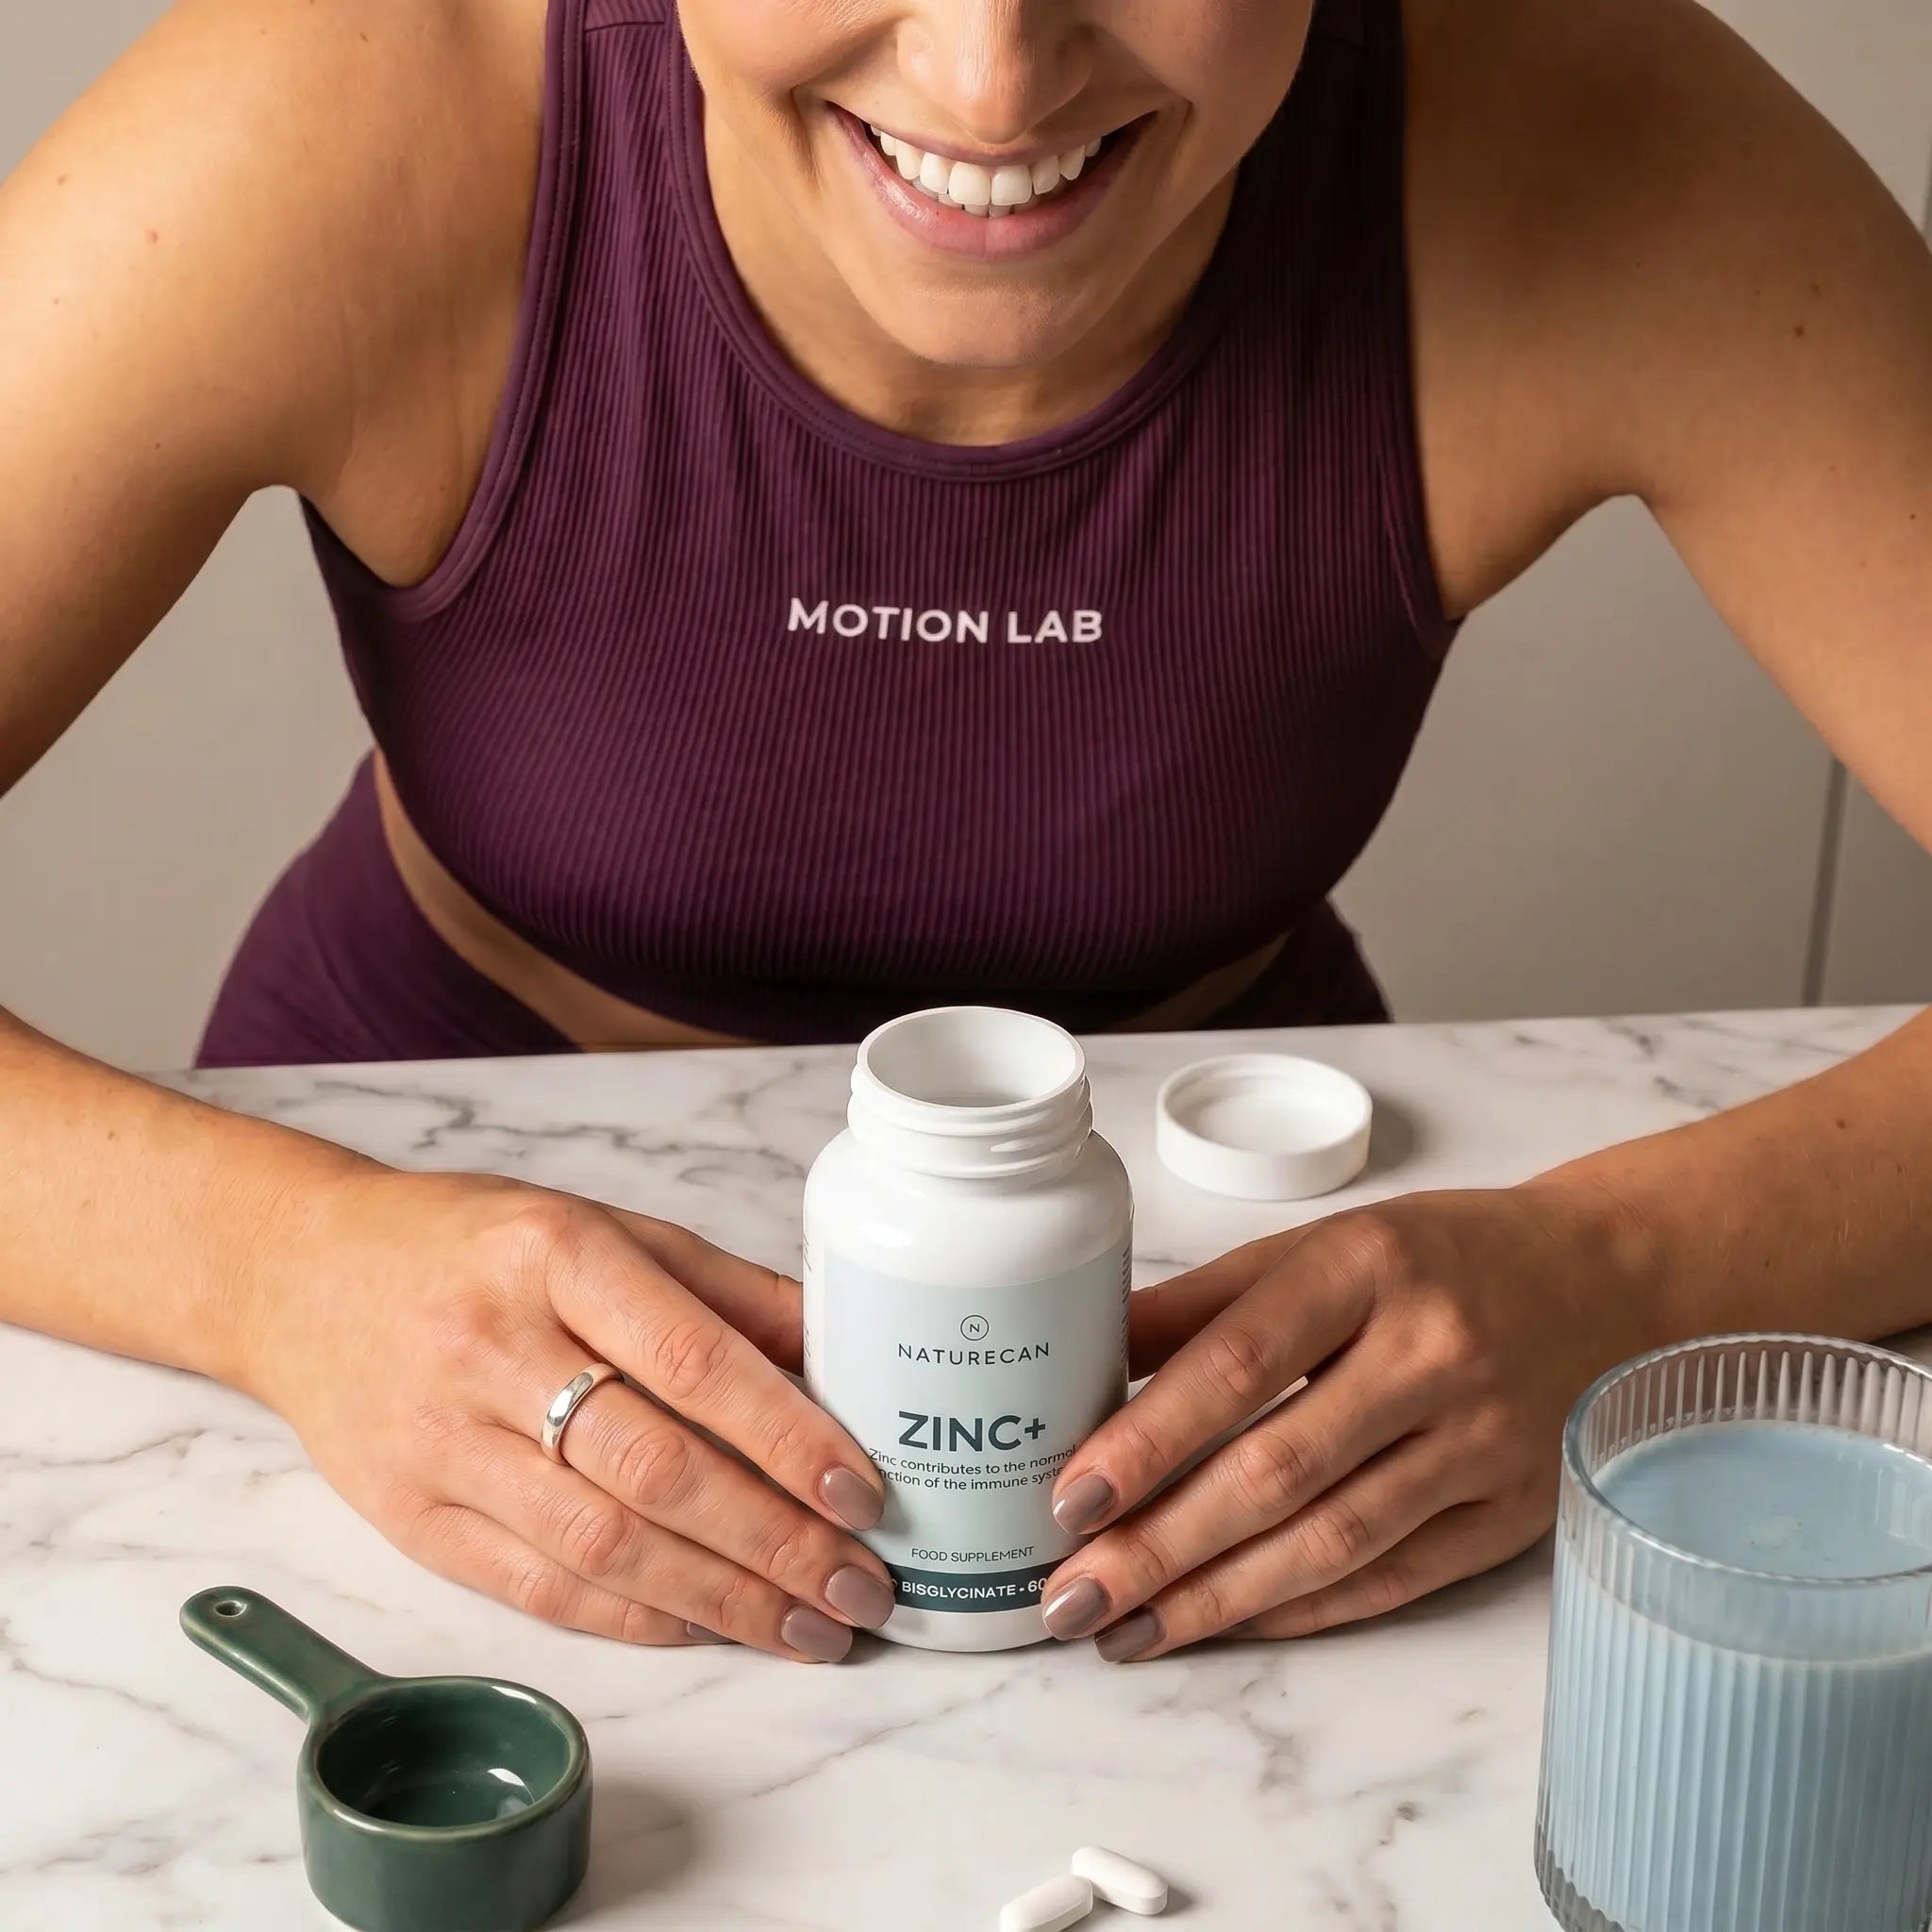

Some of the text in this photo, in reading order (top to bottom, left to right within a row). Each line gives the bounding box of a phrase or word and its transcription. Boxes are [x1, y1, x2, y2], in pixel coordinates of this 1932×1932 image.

[787, 597, 1103, 644] MOTION LAB
[969, 1324, 980, 1333] N
[898, 1341, 1049, 1365] NATURECAN
[898, 1410, 1046, 1452] ZINC+
[869, 1444, 1075, 1474] Zinc contributes to the normal
[878, 1466, 1064, 1491] nction of the immune syste
[911, 1546, 1034, 1562] FOOD SUPPLEMENT
[901, 1581, 1016, 1599] BISGLYCINATE
